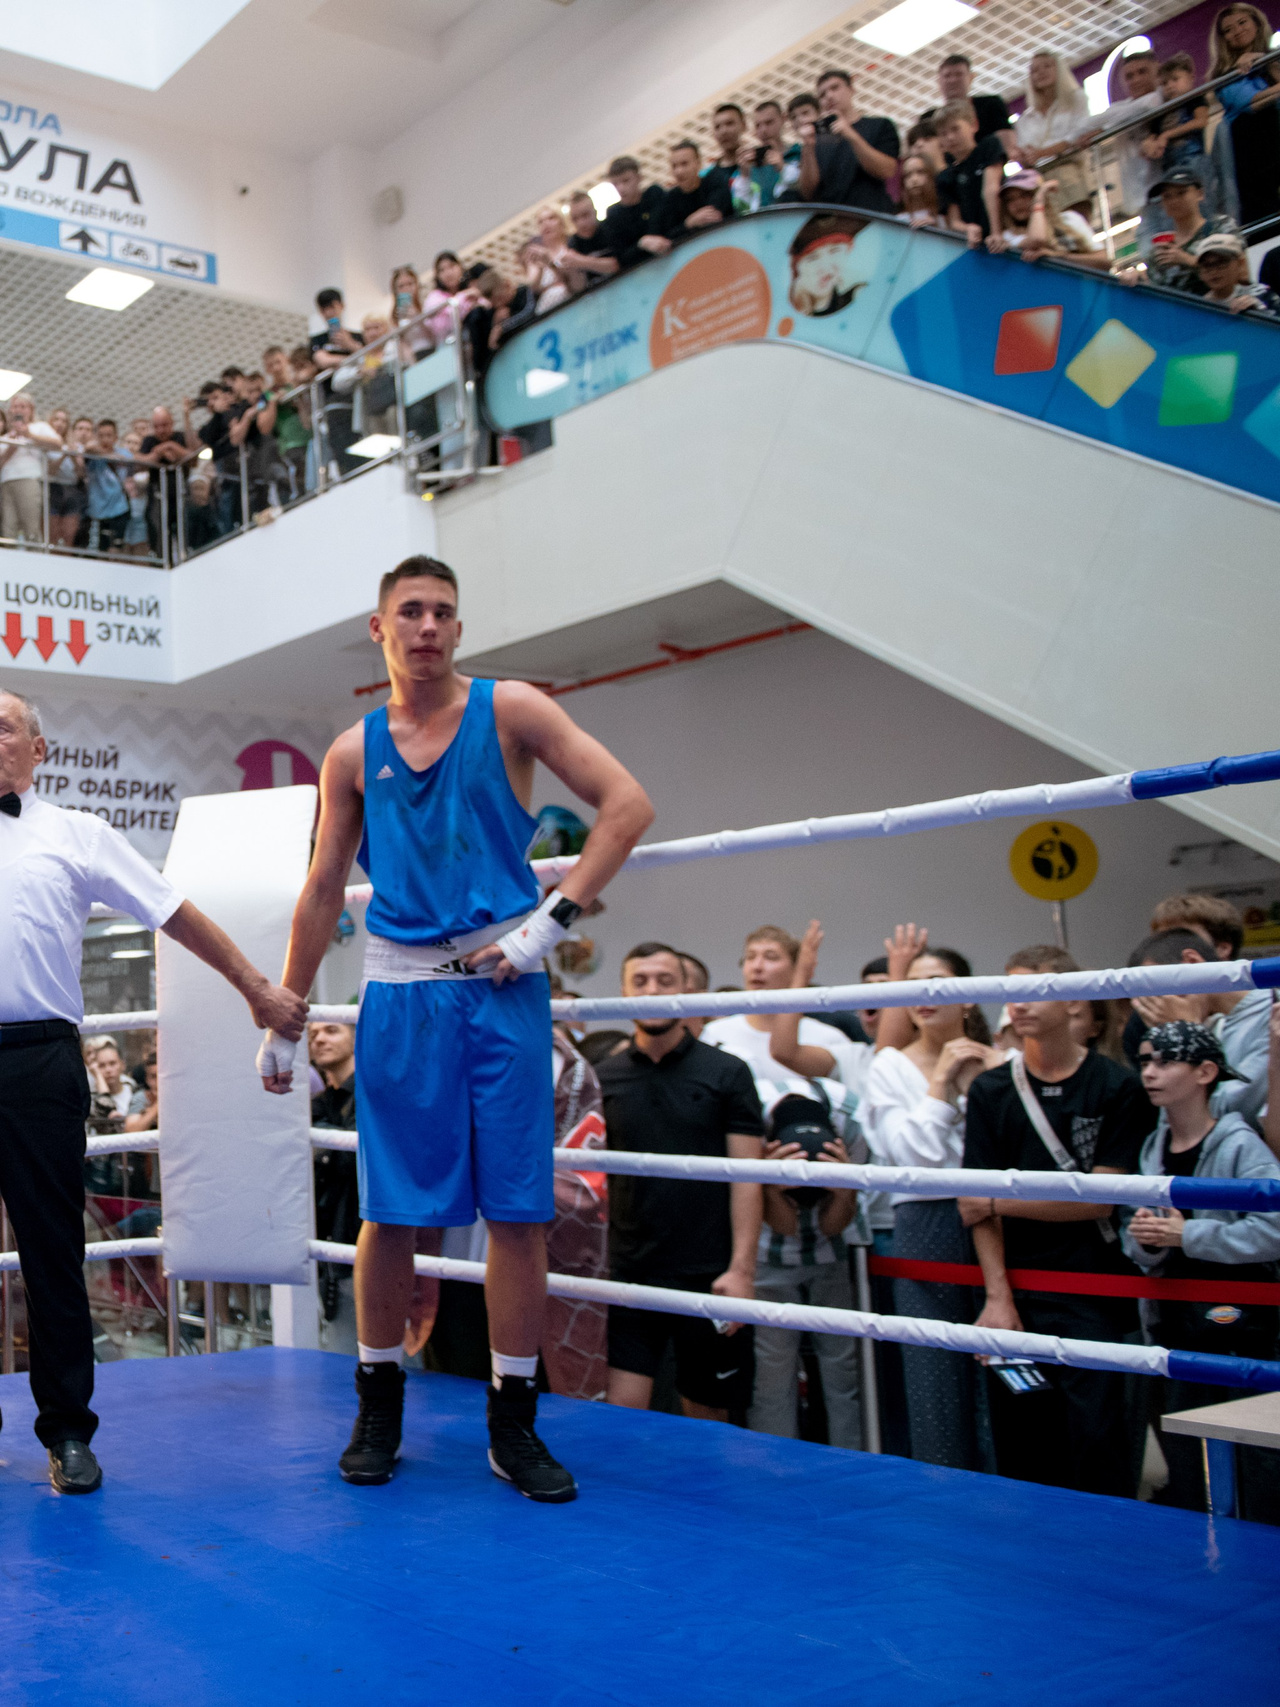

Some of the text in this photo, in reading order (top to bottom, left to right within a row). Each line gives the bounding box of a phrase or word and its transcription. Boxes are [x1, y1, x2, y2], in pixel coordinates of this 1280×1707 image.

[15, 186, 147, 229] ВОЖДЕНИЯ
[537, 328, 563, 372] 3
[4, 581, 161, 618] ЦОКОЛЬНЫЙ
[96, 621, 162, 648] ЭТАЖ
[78, 777, 177, 804] ФАБРИК
